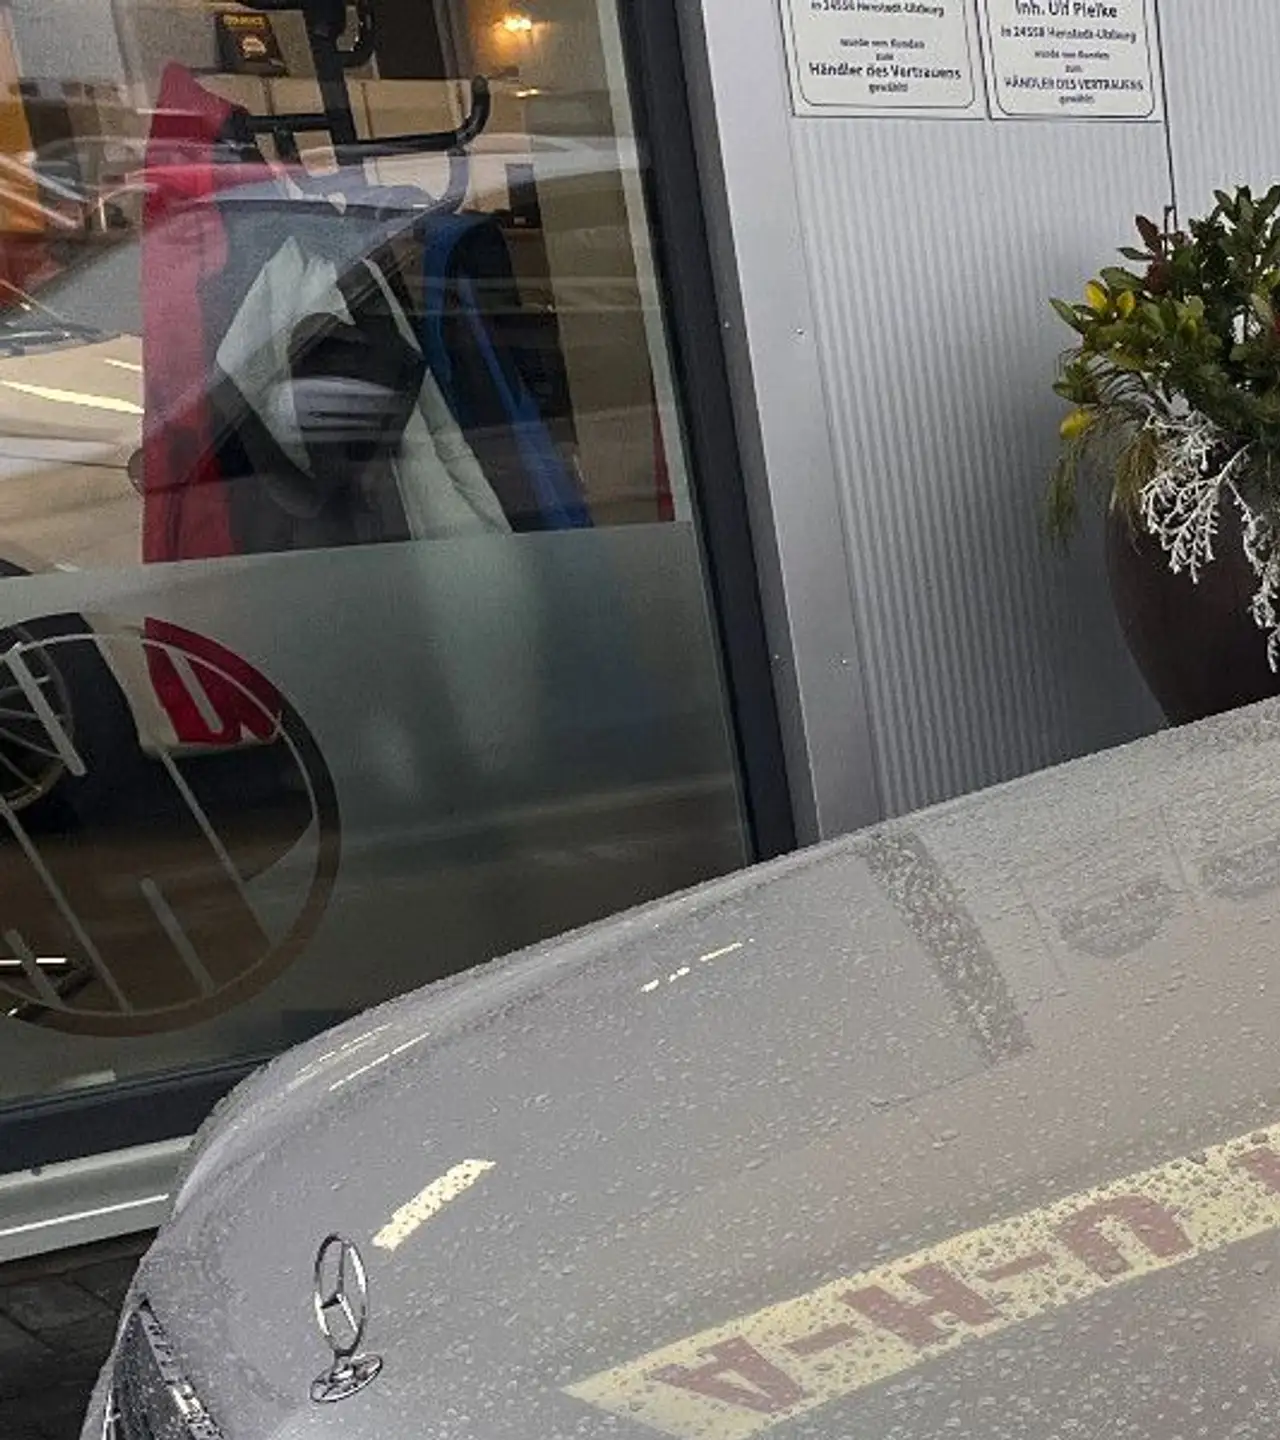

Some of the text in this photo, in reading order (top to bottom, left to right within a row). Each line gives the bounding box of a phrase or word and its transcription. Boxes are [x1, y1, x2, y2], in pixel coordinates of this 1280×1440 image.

[809, 62, 962, 79] Händler des Vertrauens
